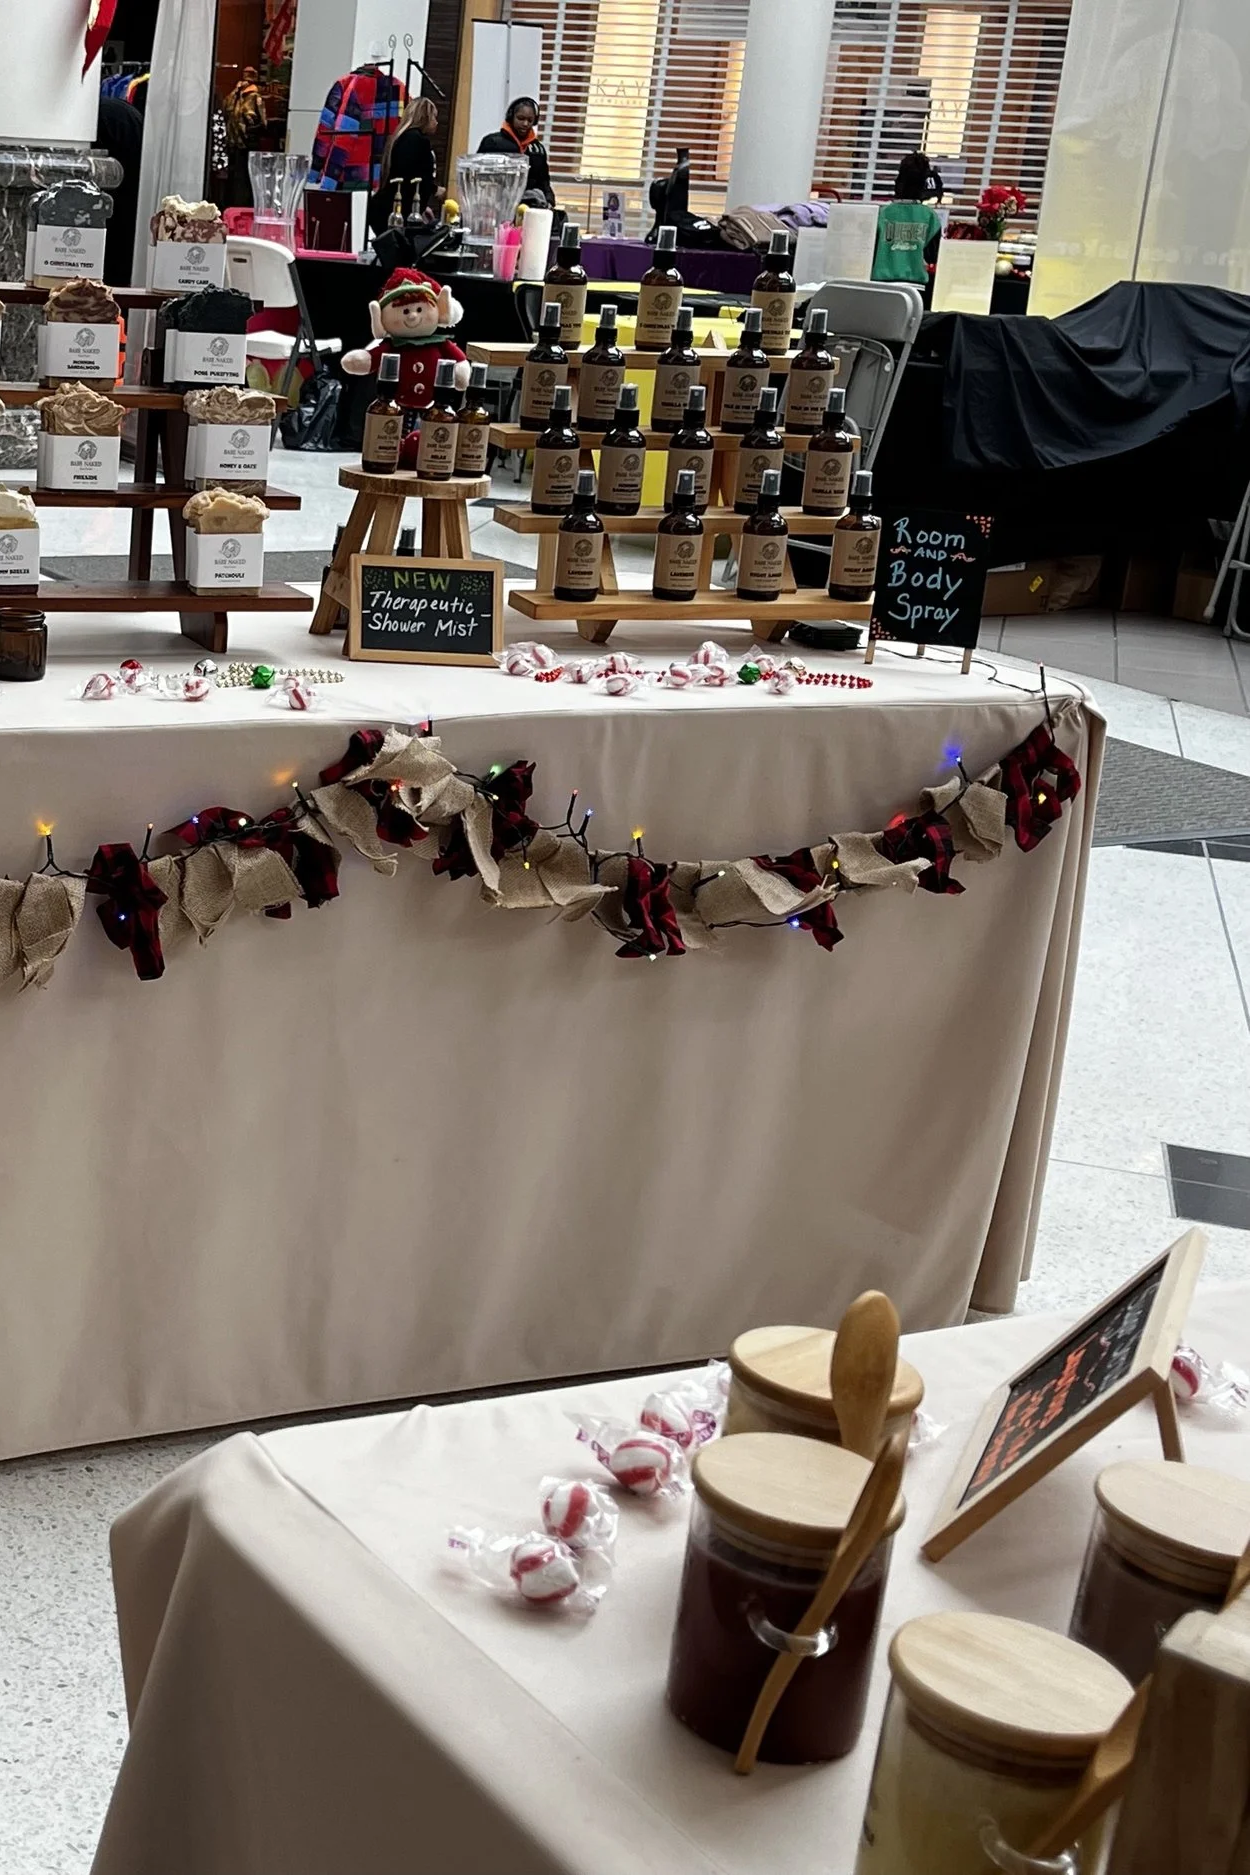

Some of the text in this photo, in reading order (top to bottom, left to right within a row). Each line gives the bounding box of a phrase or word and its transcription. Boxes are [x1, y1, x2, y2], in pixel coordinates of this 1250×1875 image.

[597, 78, 645, 97] KAY
[50, 260, 79, 268] CHRISTMAS
[893, 517, 966, 550] Room
[914, 547, 947, 561] AND
[393, 571, 450, 592] NEW
[887, 560, 963, 601] Body
[370, 590, 475, 617] Therapeutic
[887, 593, 960, 633] Spray
[368, 613, 479, 637] Shower Mist
